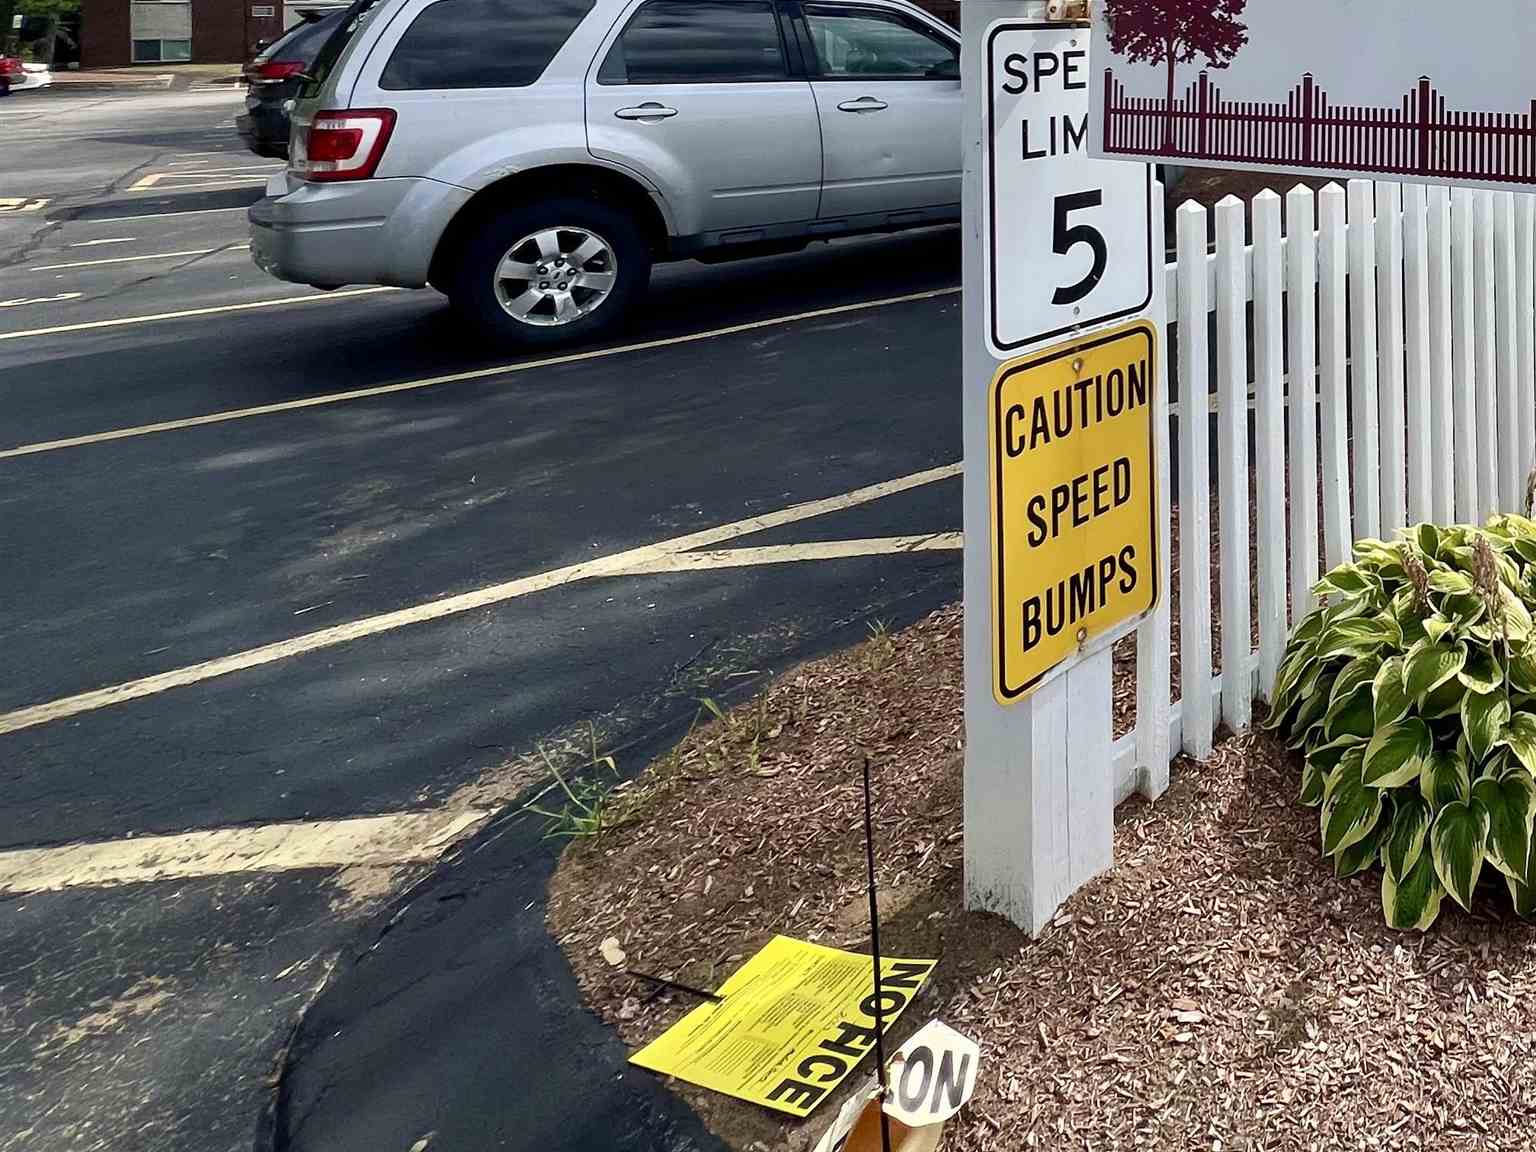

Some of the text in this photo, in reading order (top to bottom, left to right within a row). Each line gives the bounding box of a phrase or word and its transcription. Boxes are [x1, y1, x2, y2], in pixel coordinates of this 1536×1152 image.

[1002, 50, 1087, 95] SPE
[1021, 112, 1088, 160] LIM
[1051, 189, 1107, 305] 5
[1005, 359, 1147, 458] CAUTION
[1026, 456, 1132, 548] SPEED
[1022, 545, 1137, 653] BUMPS
[766, 962, 933, 1110] NOTICE
[887, 1045, 970, 1114] ON
